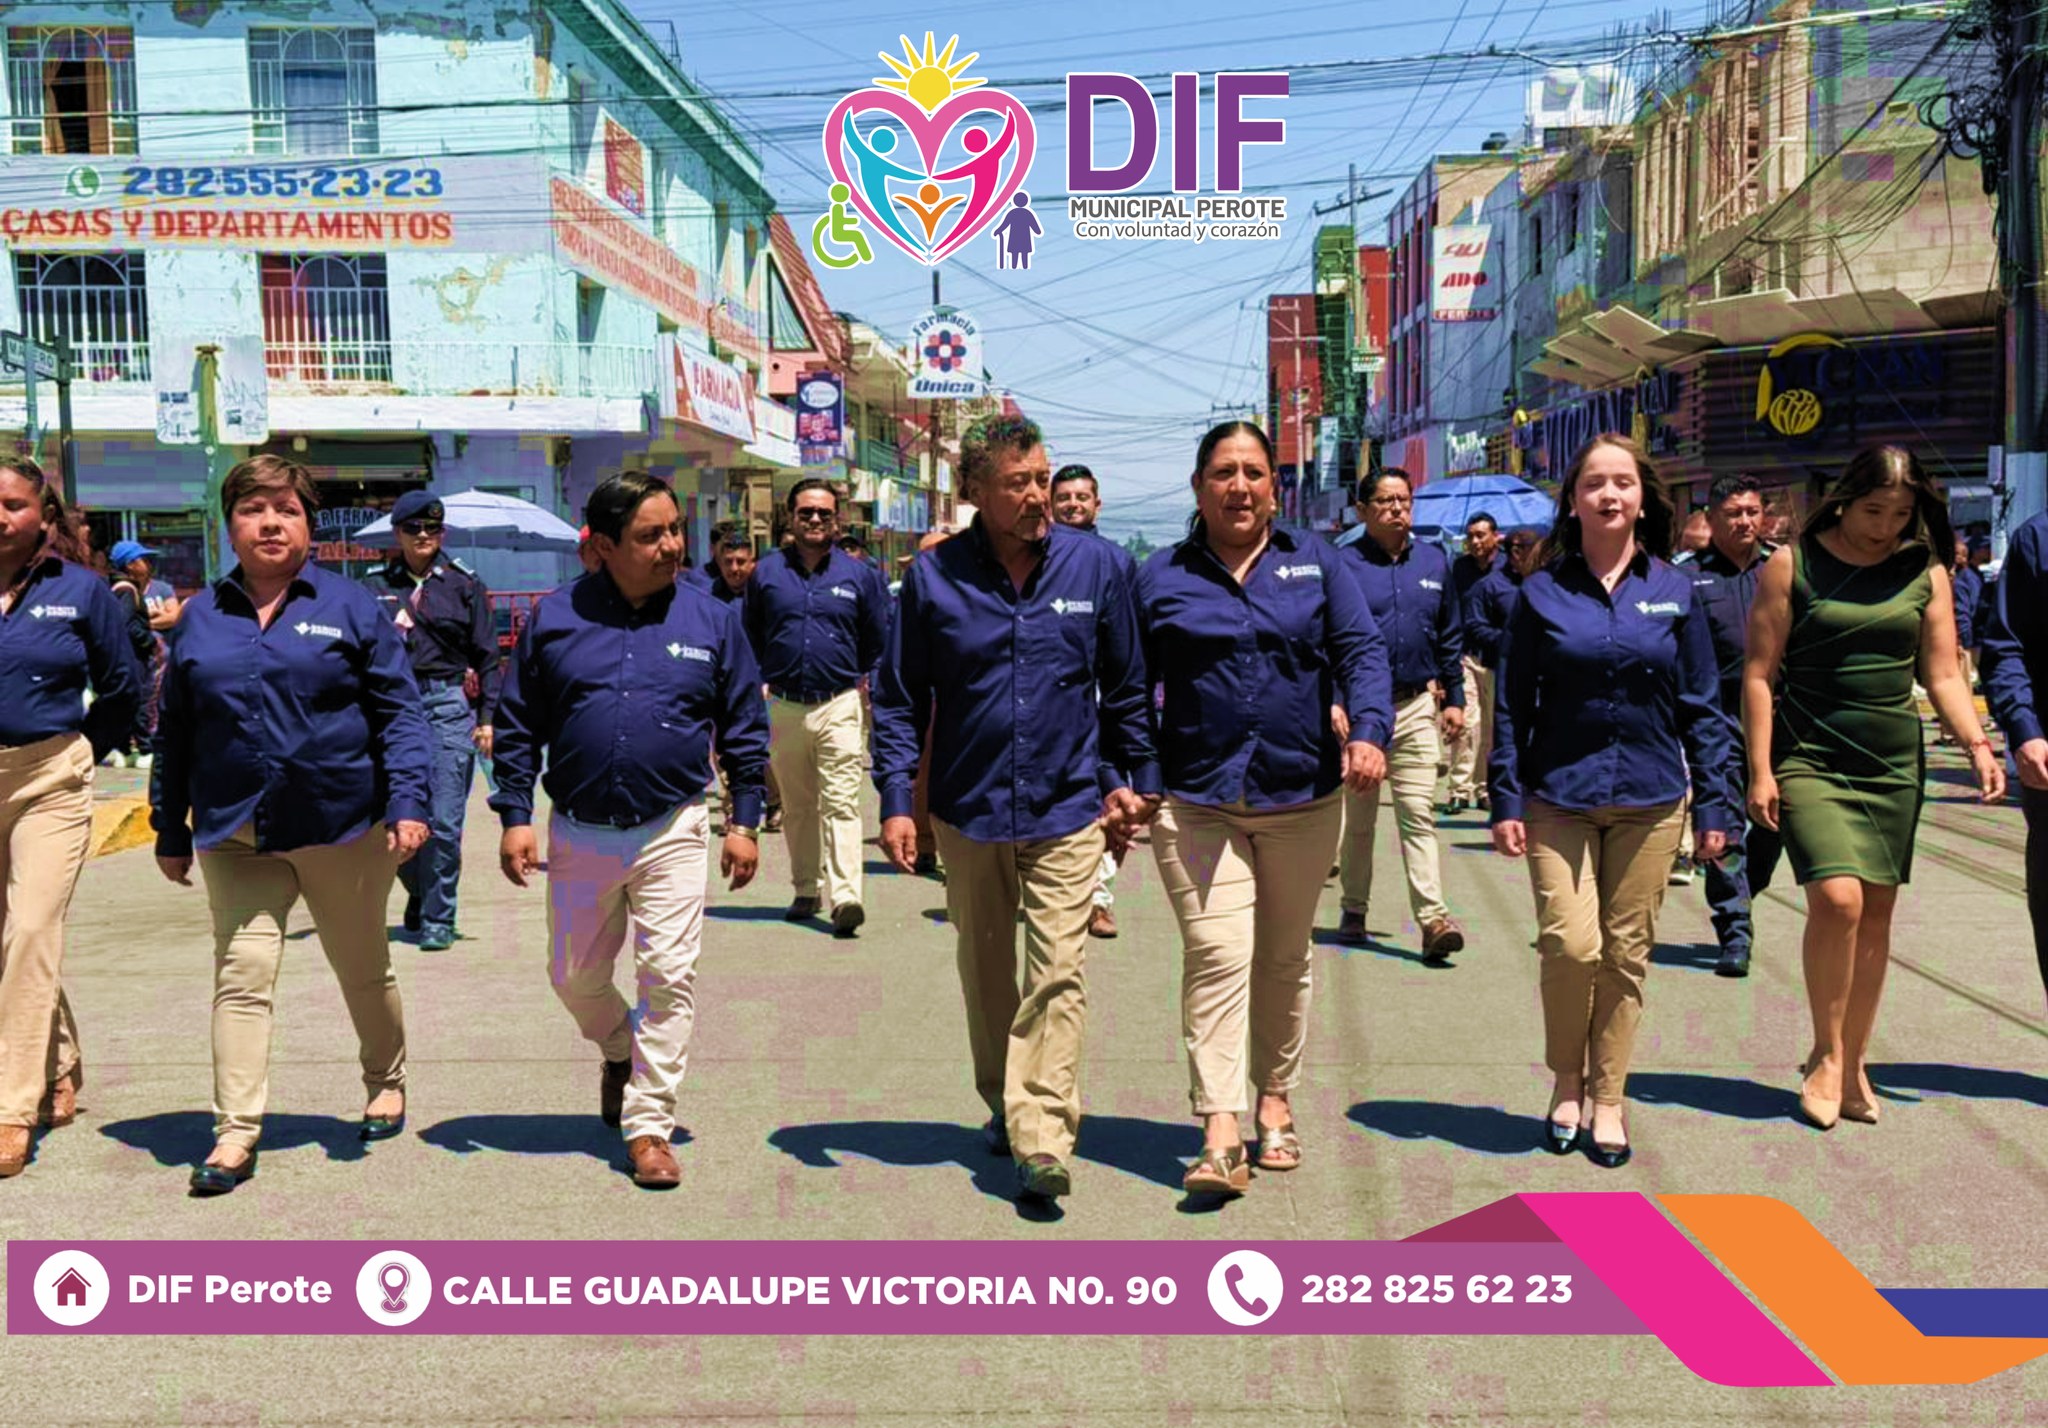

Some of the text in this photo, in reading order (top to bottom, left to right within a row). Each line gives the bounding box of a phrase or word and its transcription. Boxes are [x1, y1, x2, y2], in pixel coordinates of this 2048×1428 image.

[2, 208, 452, 240] CASAS Y DEPARTAMENTOS
[1440, 271, 1488, 288] ADO
